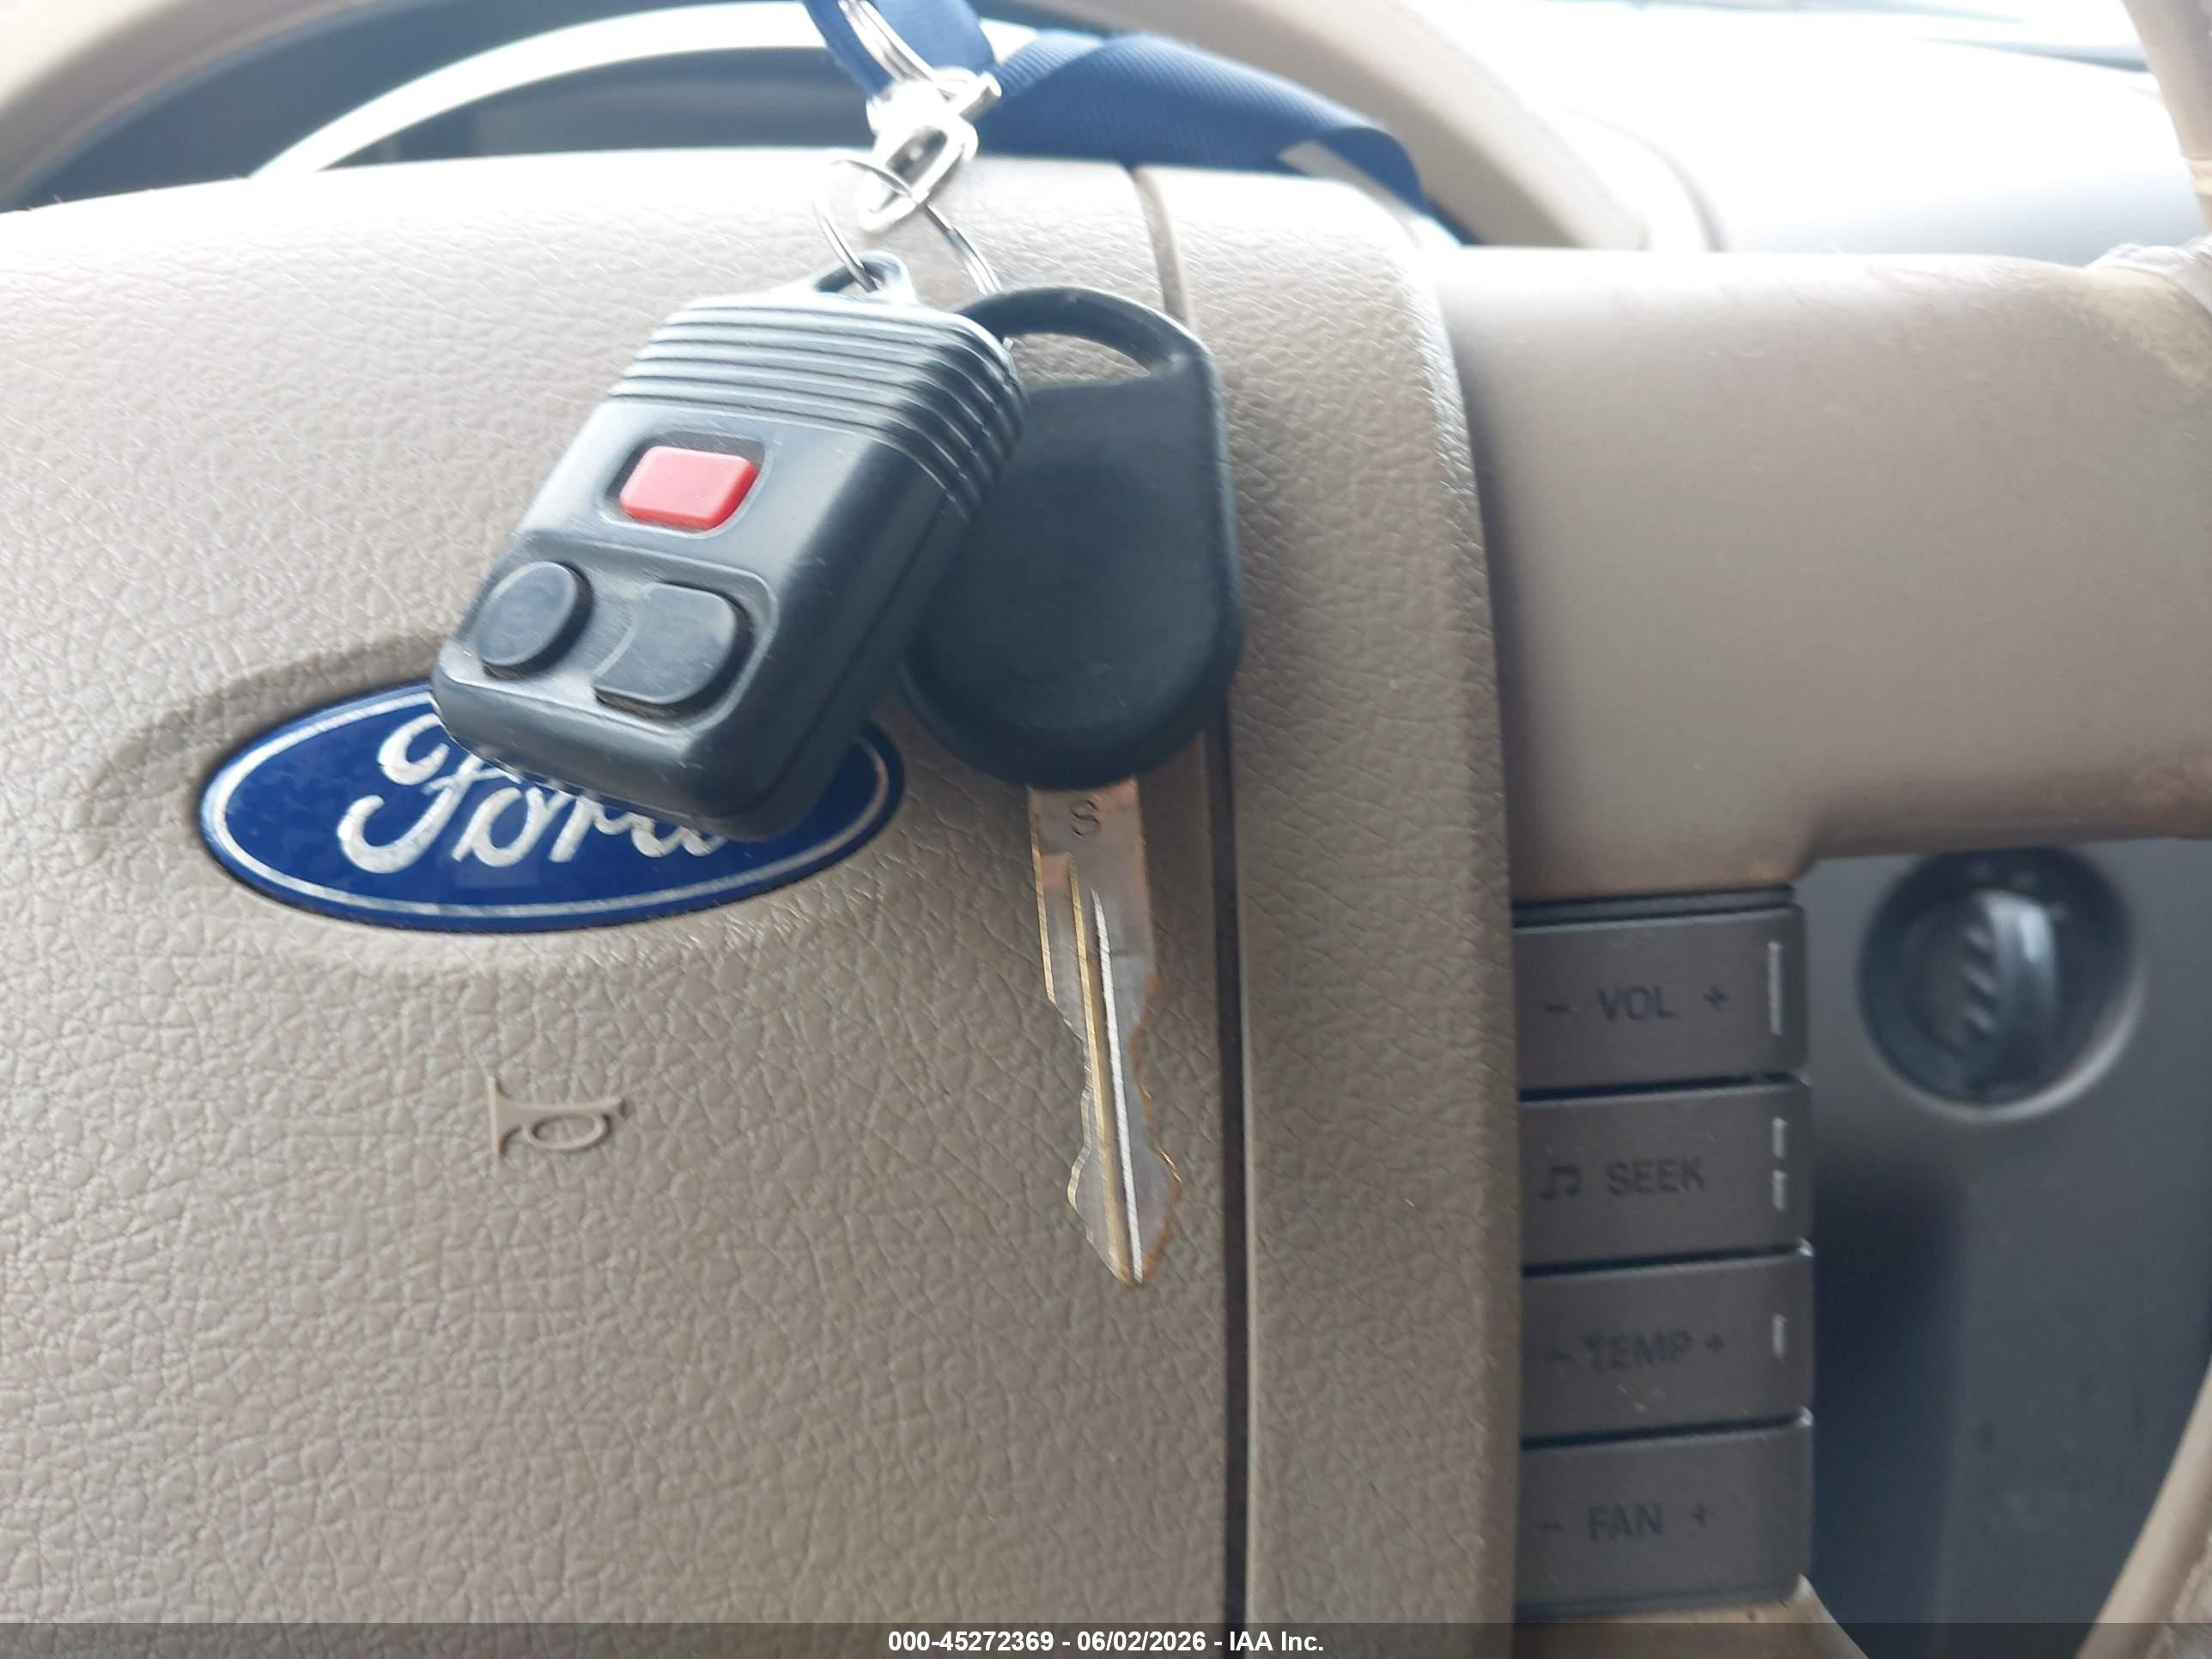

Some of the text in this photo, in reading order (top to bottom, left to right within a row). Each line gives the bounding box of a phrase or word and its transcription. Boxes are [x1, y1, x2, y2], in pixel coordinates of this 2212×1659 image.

[1072, 799, 1101, 838] S
[1597, 986, 1676, 1022] VOL
[1605, 1157, 1705, 1197] SEEK
[1582, 1330, 1692, 1370] TEMP
[1589, 1503, 1663, 1540] FAN
